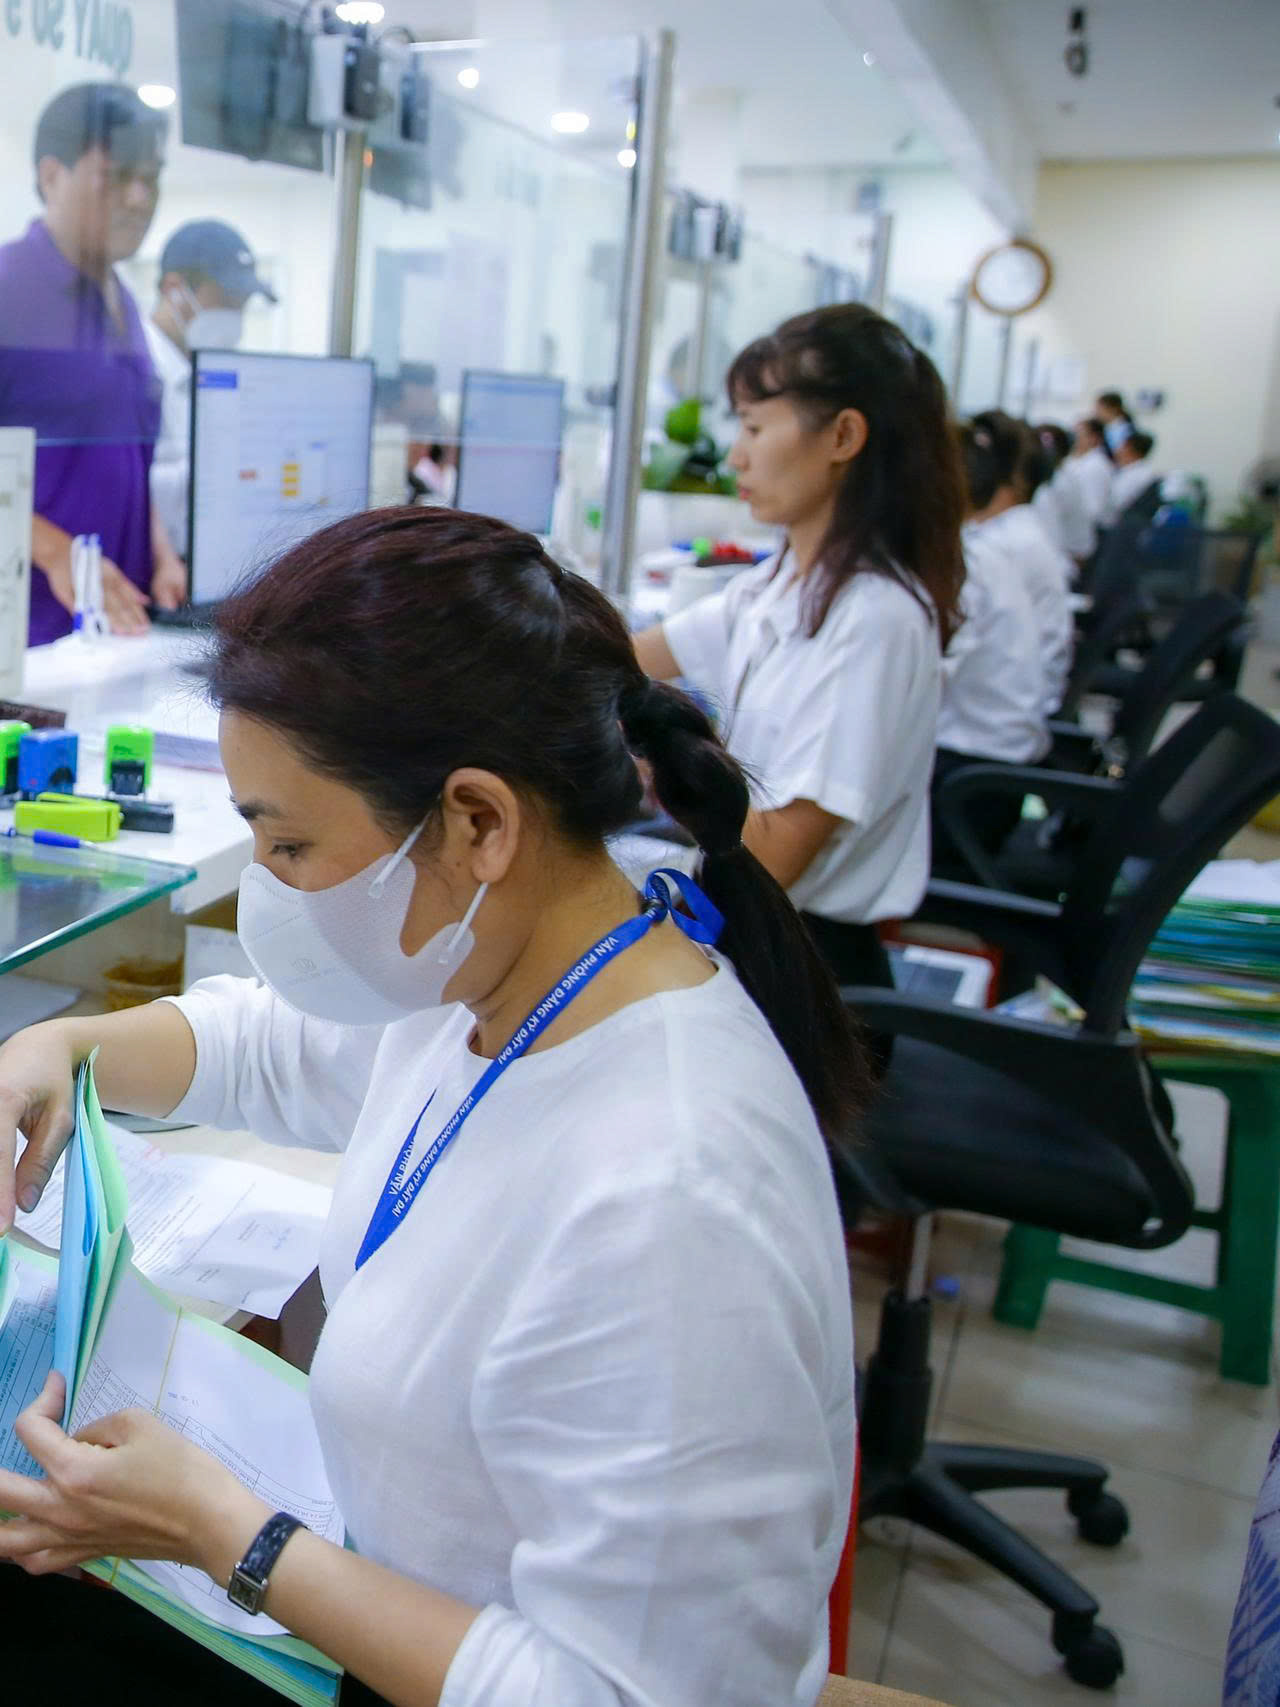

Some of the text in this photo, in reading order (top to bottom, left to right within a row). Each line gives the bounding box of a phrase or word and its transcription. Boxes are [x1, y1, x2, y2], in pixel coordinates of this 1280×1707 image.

[497, 936, 618, 1065] VĂN PHÒNG ĐĂNG KÝ ĐẤT ĐAI
[391, 1199, 405, 1218] ĐAI
